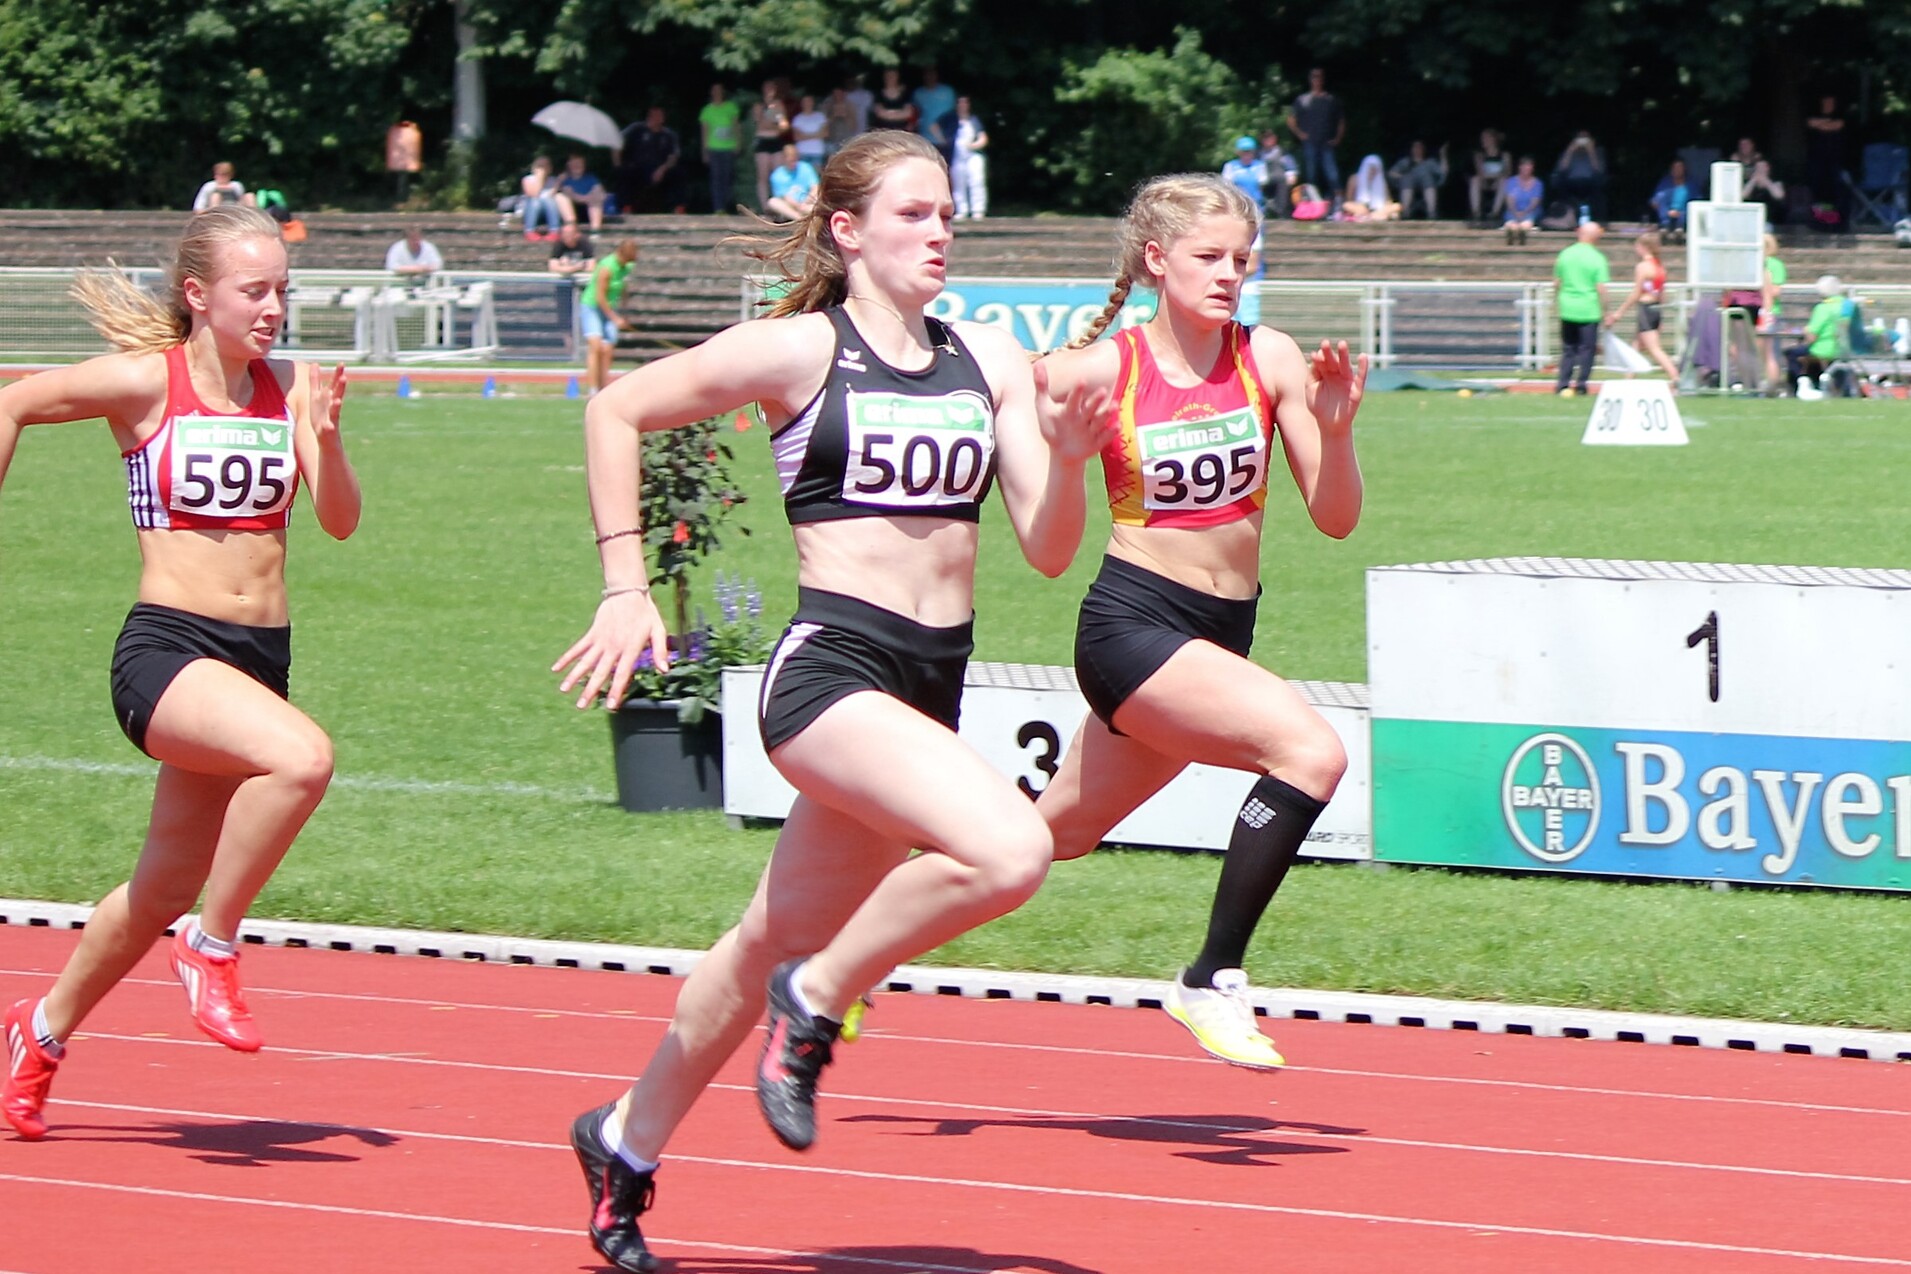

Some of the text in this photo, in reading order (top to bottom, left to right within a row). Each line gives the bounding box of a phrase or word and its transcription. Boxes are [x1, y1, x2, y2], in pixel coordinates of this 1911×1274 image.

[185, 424, 259, 446] erima
[1153, 426, 1225, 452] erima
[1637, 398, 1669, 432] 30
[181, 454, 286, 511] 595
[854, 433, 983, 497] 500
[1153, 444, 1257, 505] 395
[1686, 611, 1719, 702] 1
[1017, 720, 1060, 804] 3
[1512, 785, 1595, 810] BAYER
[1543, 744, 1566, 852] BAYER
